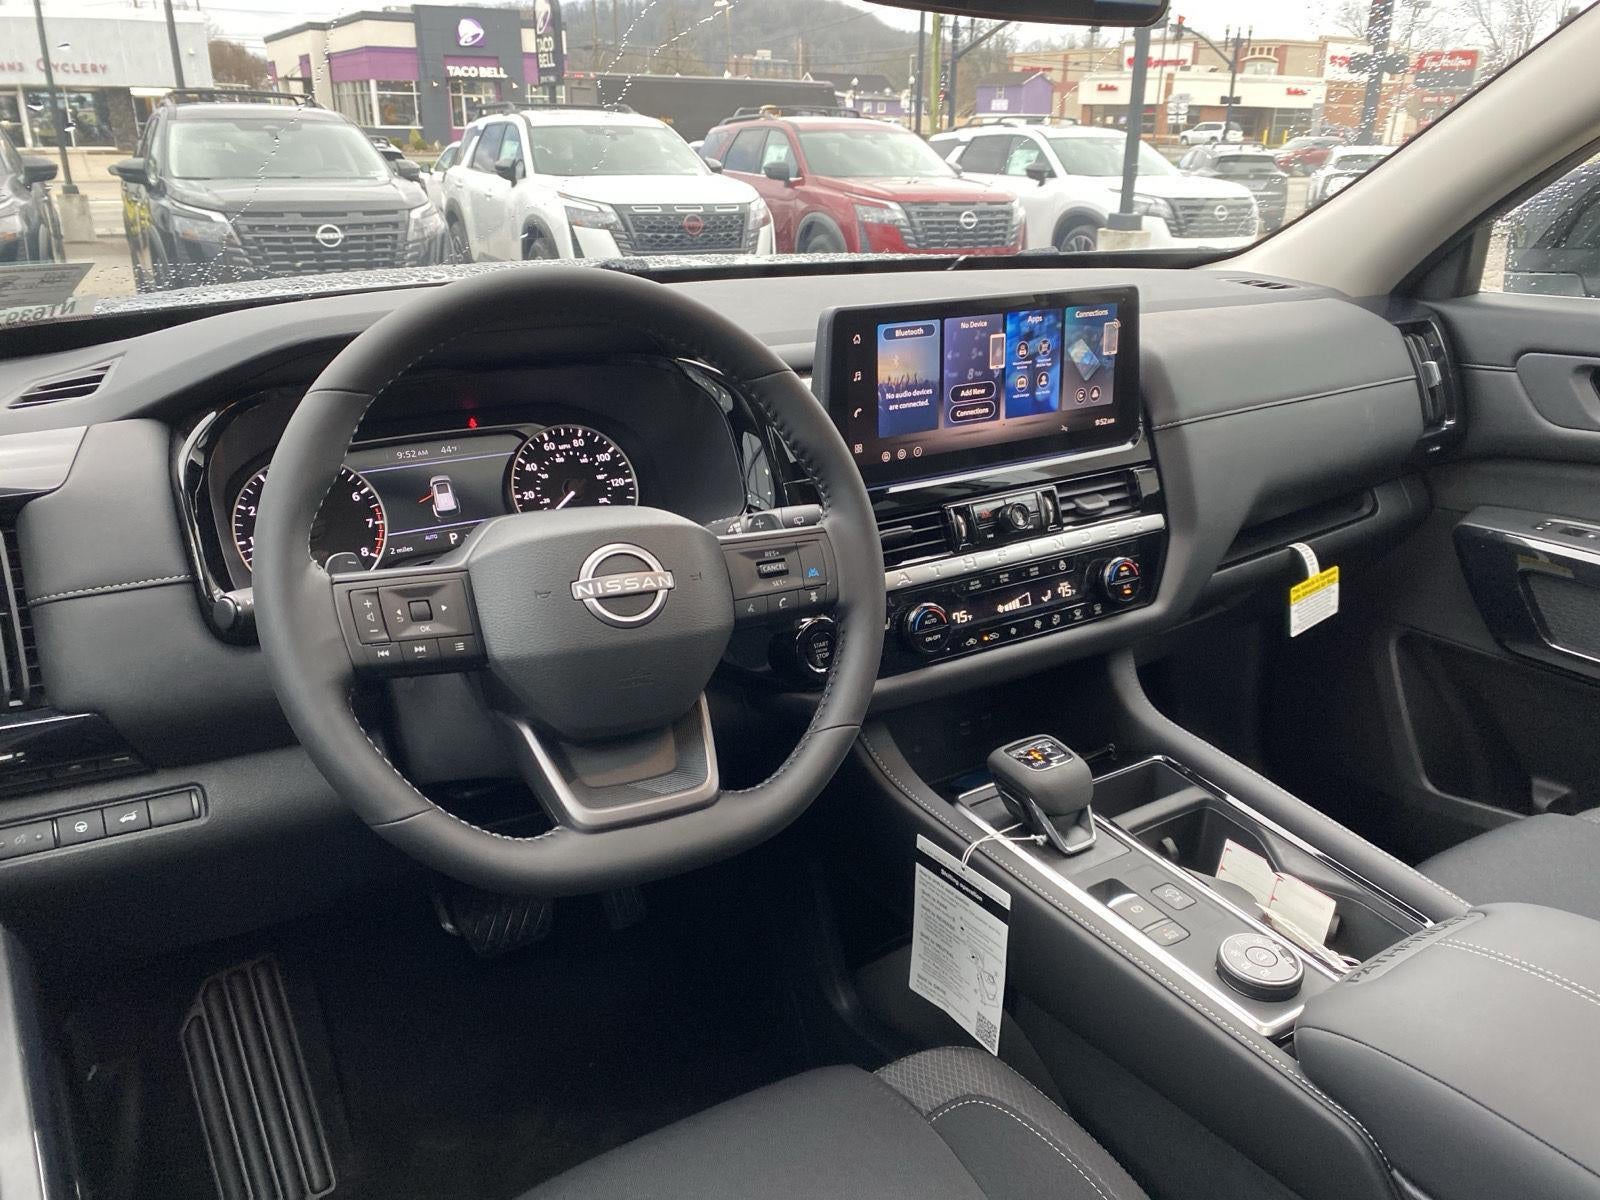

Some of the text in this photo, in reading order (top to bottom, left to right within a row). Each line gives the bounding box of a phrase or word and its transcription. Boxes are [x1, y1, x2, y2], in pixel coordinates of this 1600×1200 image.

[538, 53, 556, 68] BELL
[447, 65, 508, 78] TACO BELL
[1075, 309, 1109, 318] Connections
[960, 320, 988, 329] No Device
[1027, 315, 1043, 324] Apps
[895, 327, 924, 337] Bluetooth
[886, 387, 933, 400] No audio devices
[960, 387, 986, 397] Add New
[889, 403, 899, 411] are
[956, 406, 989, 417] Connections
[543, 442, 556, 451] 60
[572, 438, 585, 447] 80
[396, 450, 417, 460] 9:52
[595, 452, 611, 462] 100
[525, 462, 538, 472] 40
[610, 477, 625, 487] 120
[351, 491, 361, 502] 6
[522, 490, 535, 500] 20
[247, 506, 257, 516] 2
[365, 518, 374, 528] 7
[424, 533, 438, 541] AUTO
[449, 532, 458, 545] P
[360, 546, 370, 557] 8
[390, 546, 414, 555] 2 miles
[896, 520, 1146, 586] ATHFINDER
[762, 563, 786, 573] CANCEL
[575, 574, 673, 597] NISSAN
[419, 625, 432, 633] OK
[813, 640, 829, 649] START
[816, 652, 830, 660] STOP
